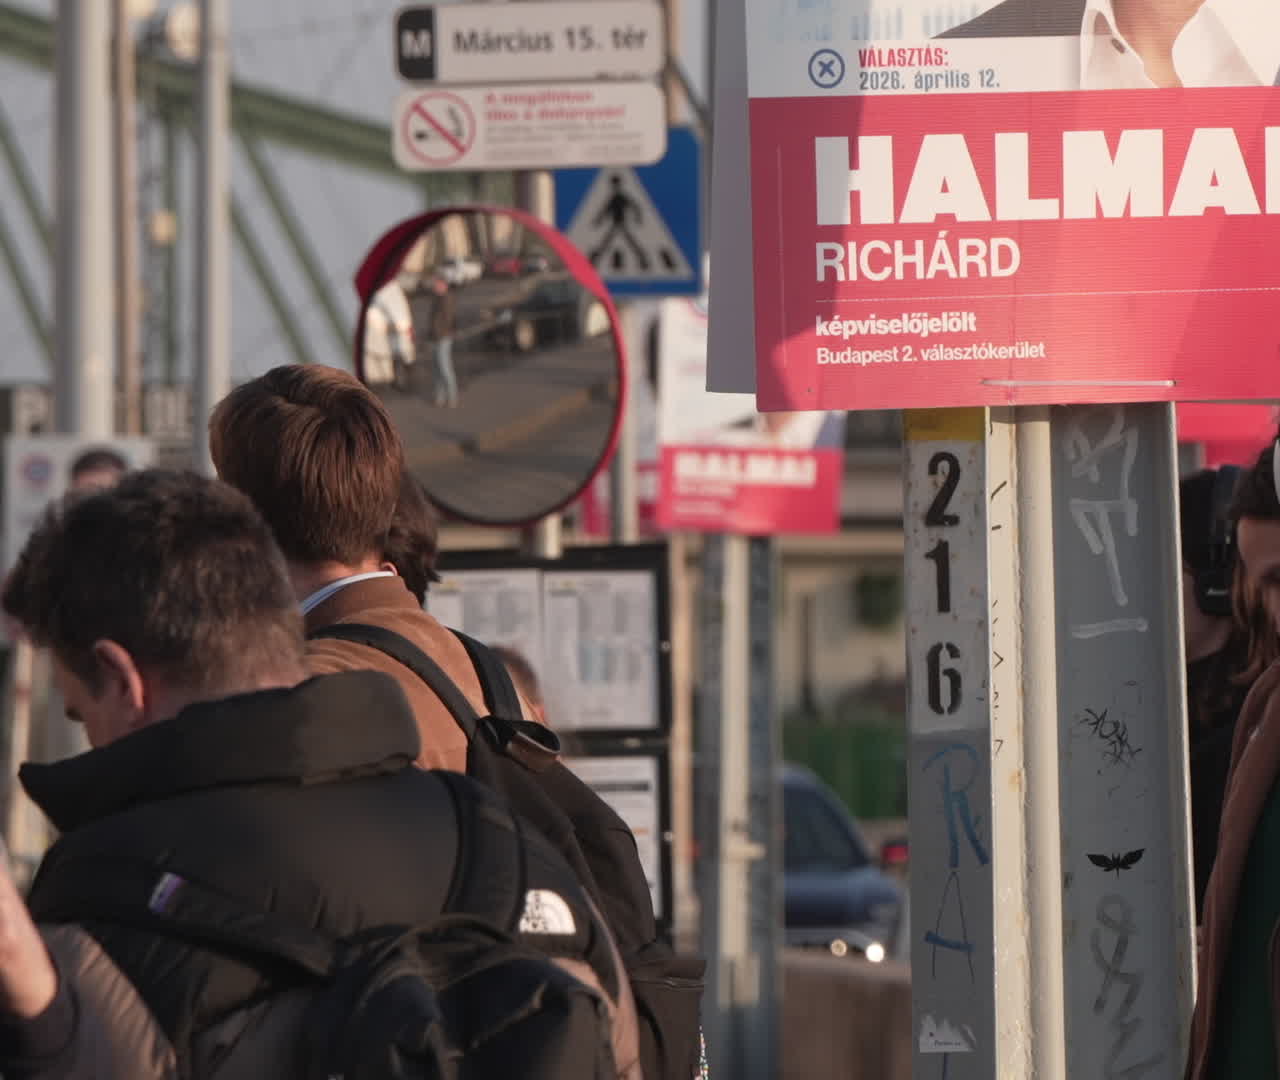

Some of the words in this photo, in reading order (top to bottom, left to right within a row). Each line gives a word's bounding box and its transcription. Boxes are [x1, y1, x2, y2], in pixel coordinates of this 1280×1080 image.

[401, 28, 433, 59] M
[453, 28, 555, 53] Március
[565, 26, 604, 51] 15.
[611, 26, 648, 51] tér
[857, 43, 949, 68] VÁLASZTÁS:
[858, 71, 905, 91] 2026.
[914, 69, 971, 92] április
[978, 67, 1000, 88] 12.
[815, 230, 1022, 282] RICHÁRD
[815, 311, 977, 340] képviselőjelölt
[816, 346, 898, 367] Budapest
[901, 345, 918, 362] 2.
[919, 340, 1047, 362] választókerület
